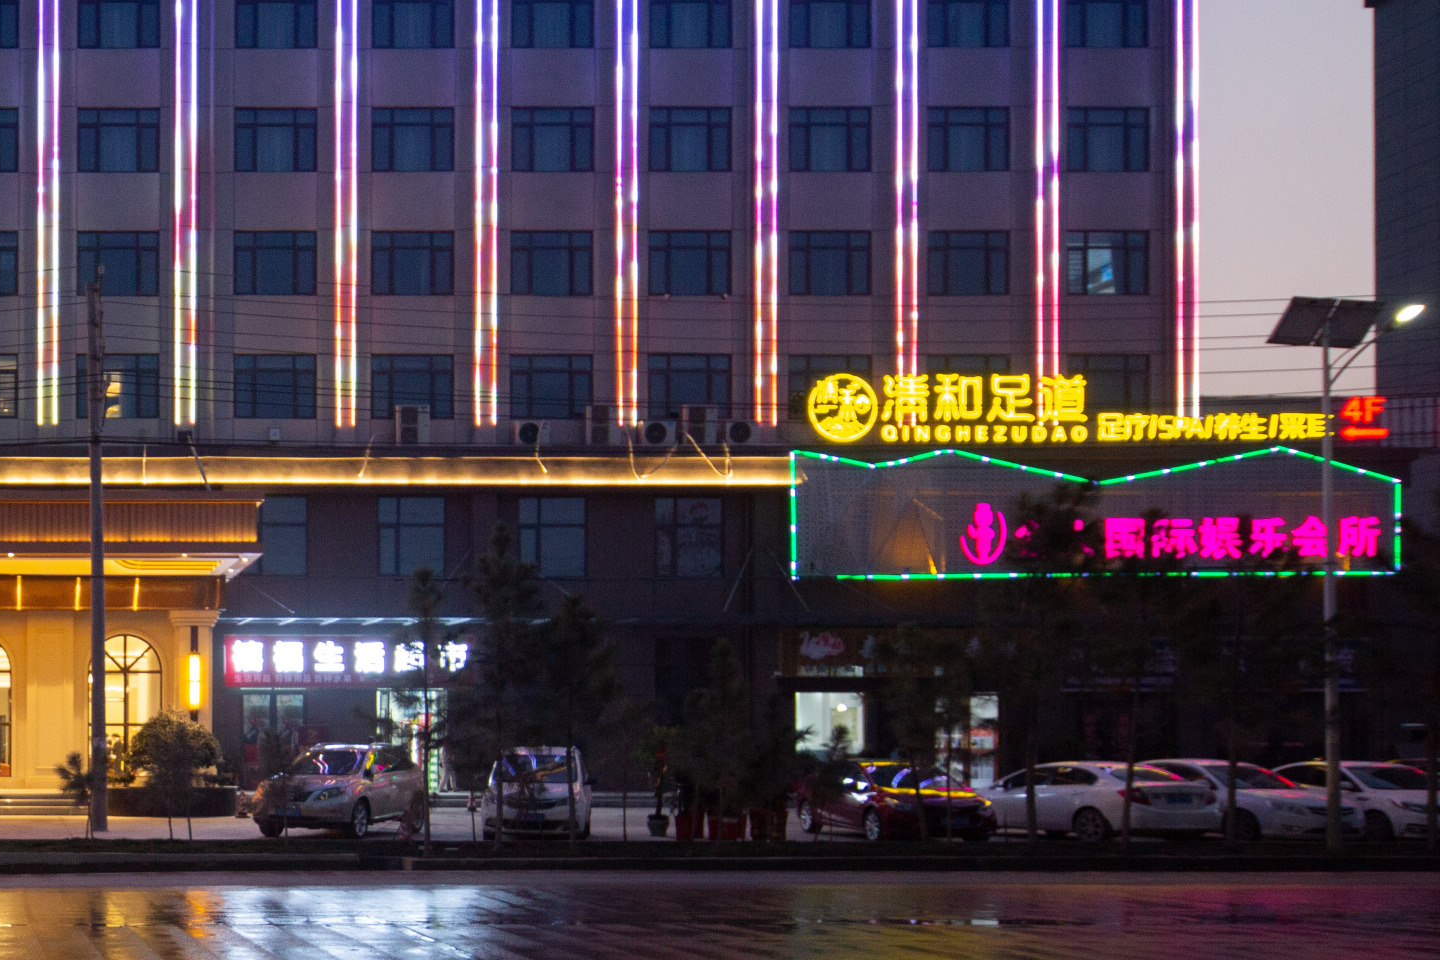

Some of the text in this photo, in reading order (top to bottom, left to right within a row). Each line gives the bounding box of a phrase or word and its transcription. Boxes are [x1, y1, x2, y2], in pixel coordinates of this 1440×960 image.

[881, 373, 1089, 426] 清和足道
[1340, 396, 1388, 424] 4F
[880, 424, 1089, 444] QINGHEZUDAO
[1014, 515, 1381, 559] 国际娱乐会所
